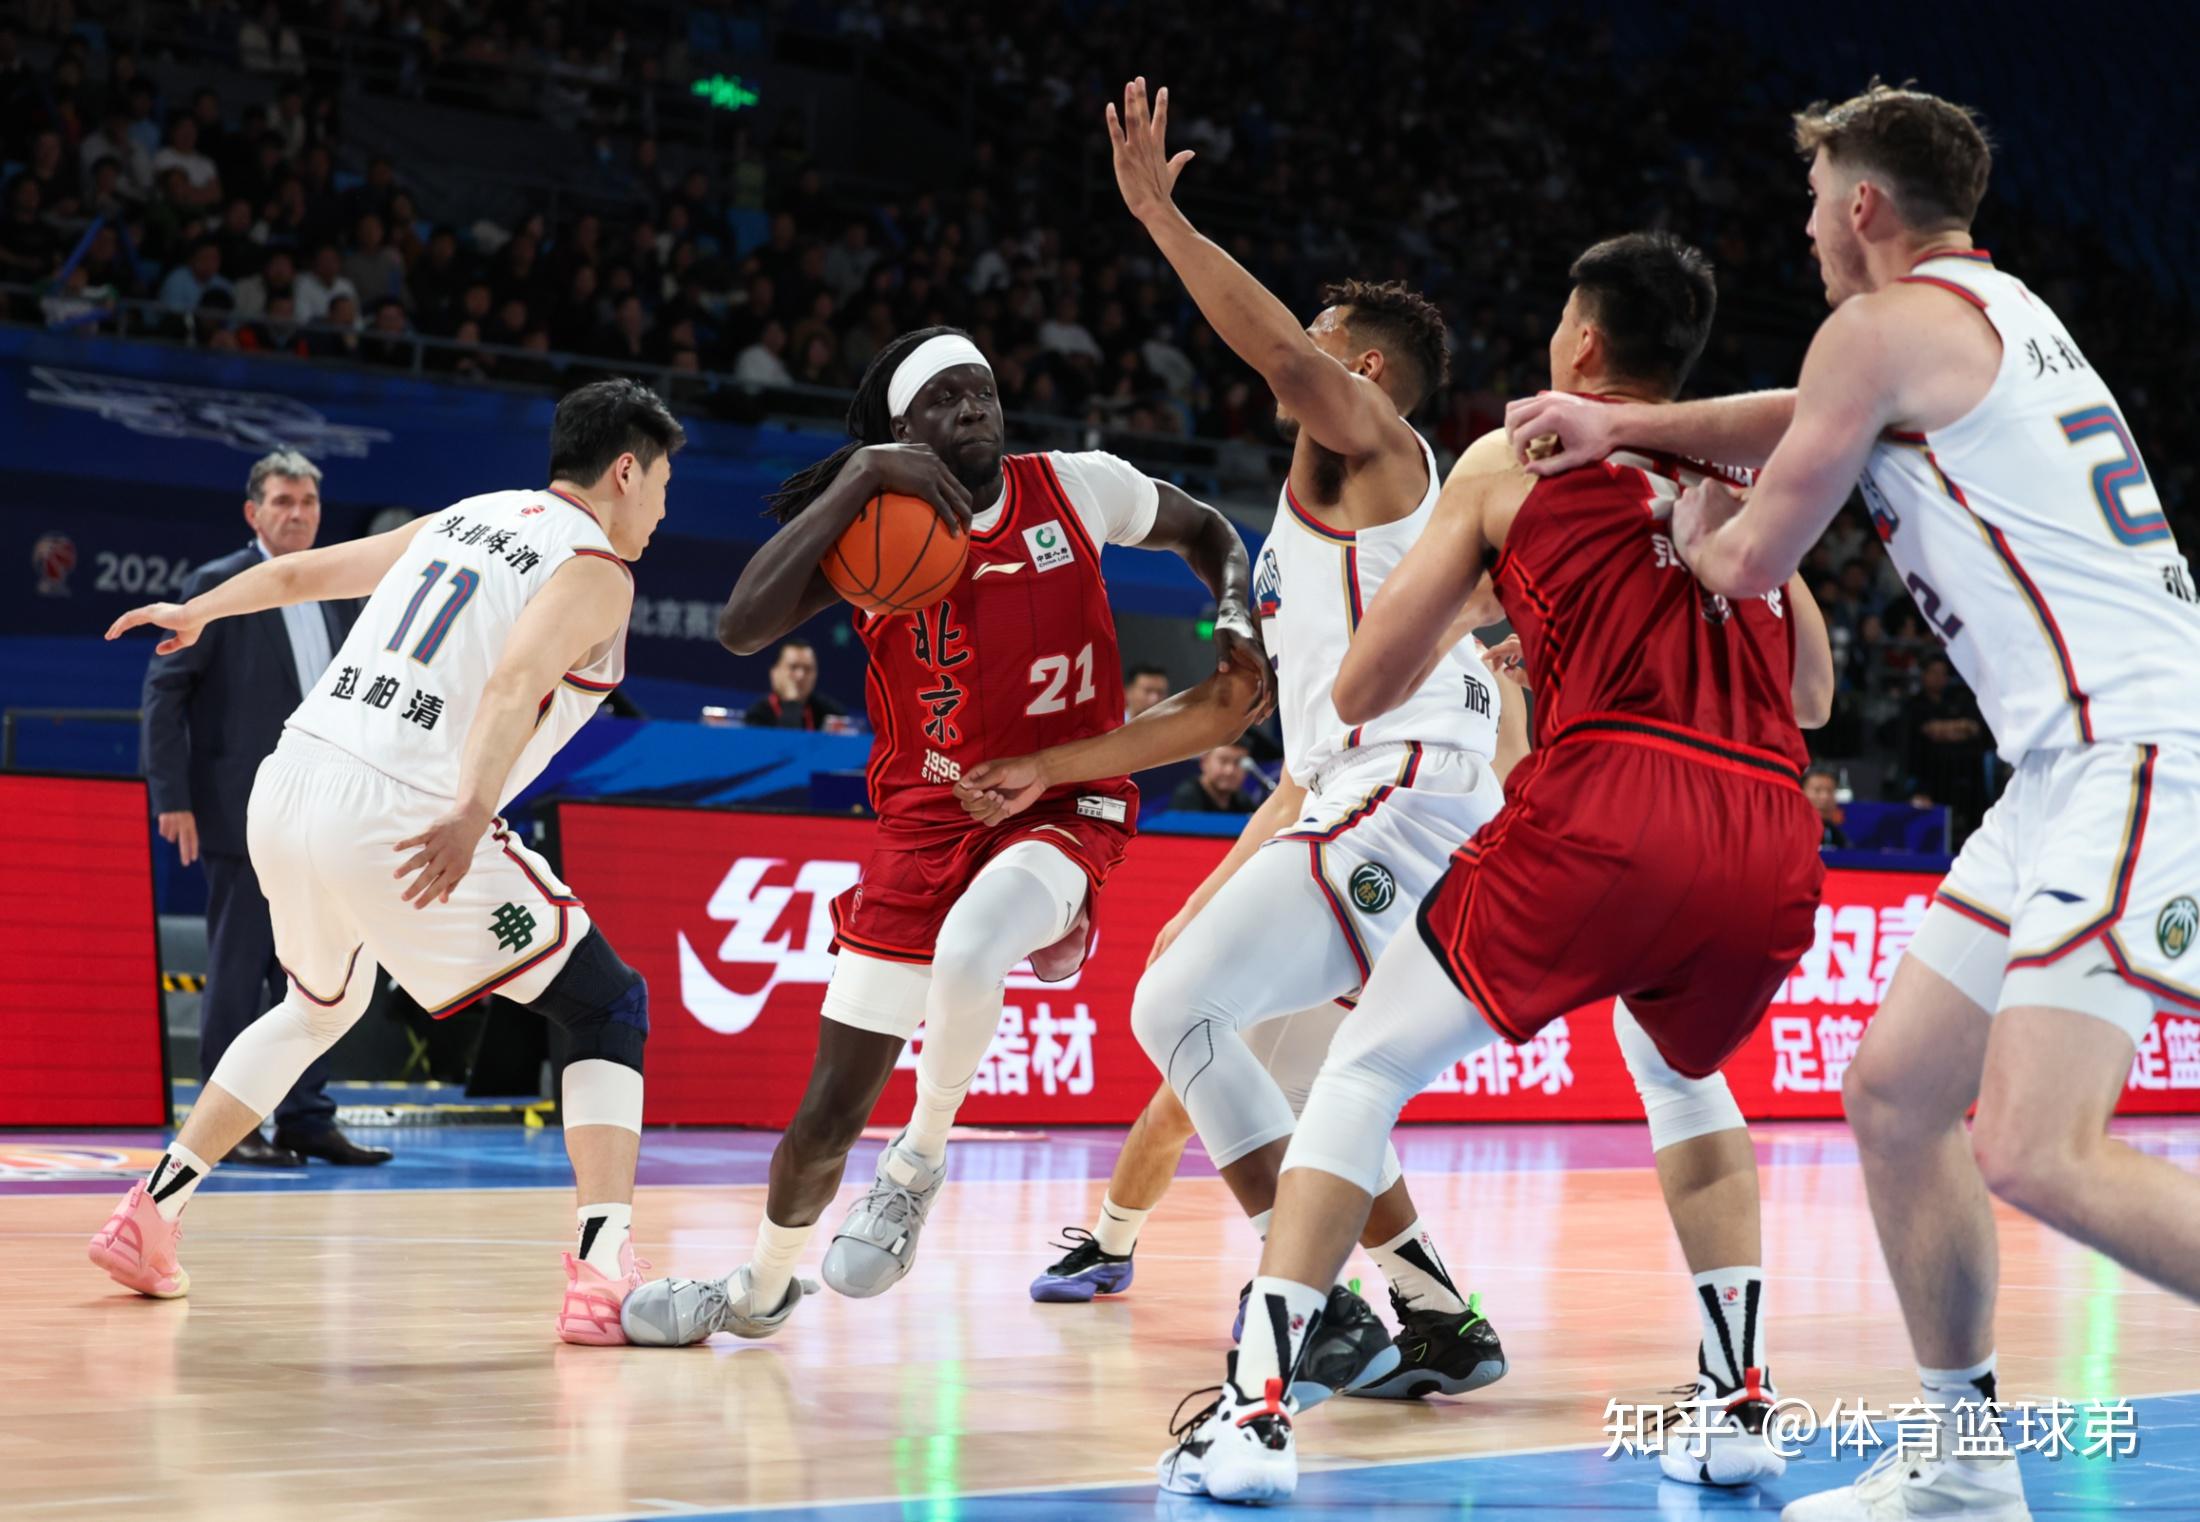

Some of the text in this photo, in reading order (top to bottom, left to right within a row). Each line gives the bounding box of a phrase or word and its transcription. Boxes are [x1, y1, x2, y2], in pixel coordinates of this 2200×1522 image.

[384, 559, 480, 667] 11
[1907, 572, 1964, 650] 2
[331, 665, 444, 730] 赵柏清
[911, 600, 969, 743] 北京
[1025, 642, 1096, 716] 21
[921, 766, 950, 784] SIN
[924, 748, 961, 780] 1956
